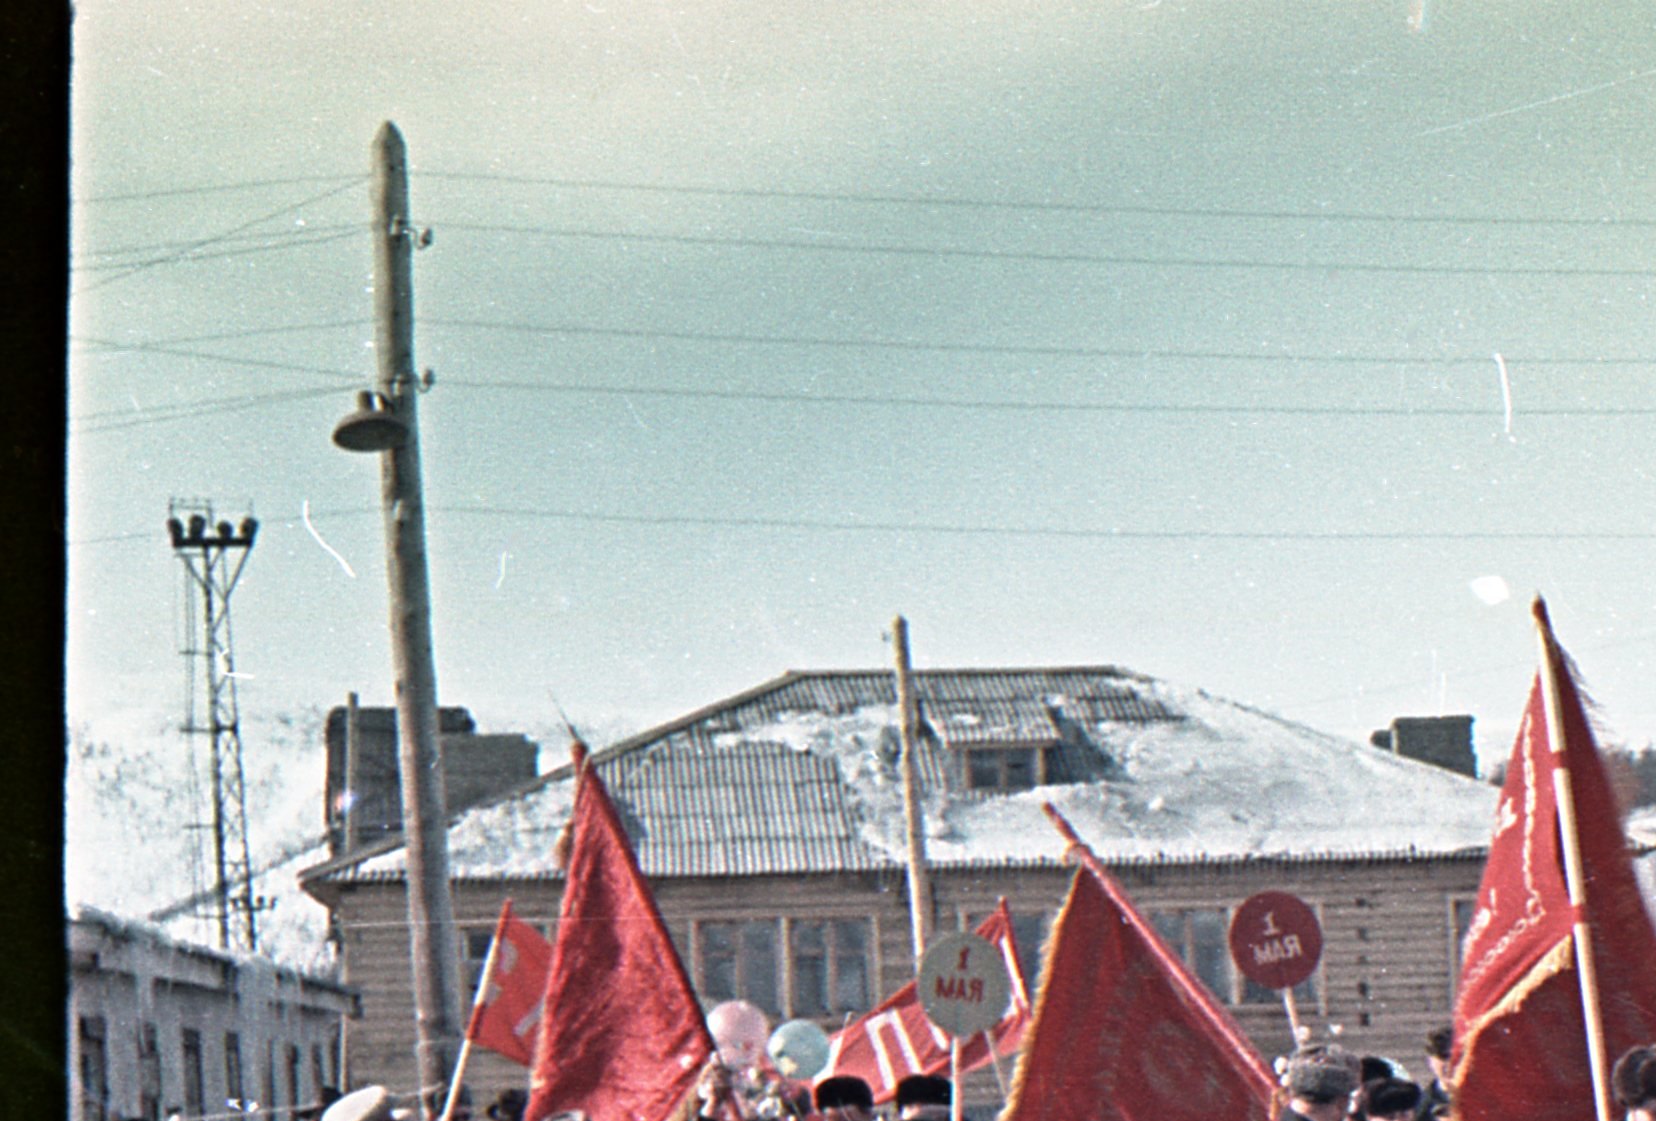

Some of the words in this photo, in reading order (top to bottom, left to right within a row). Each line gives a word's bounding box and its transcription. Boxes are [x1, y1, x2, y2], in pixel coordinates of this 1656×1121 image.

[1262, 911, 1281, 936] 1
[956, 946, 970, 971] 1
[1253, 933, 1303, 966] МАЯ
[935, 975, 985, 1003] МАЯ
